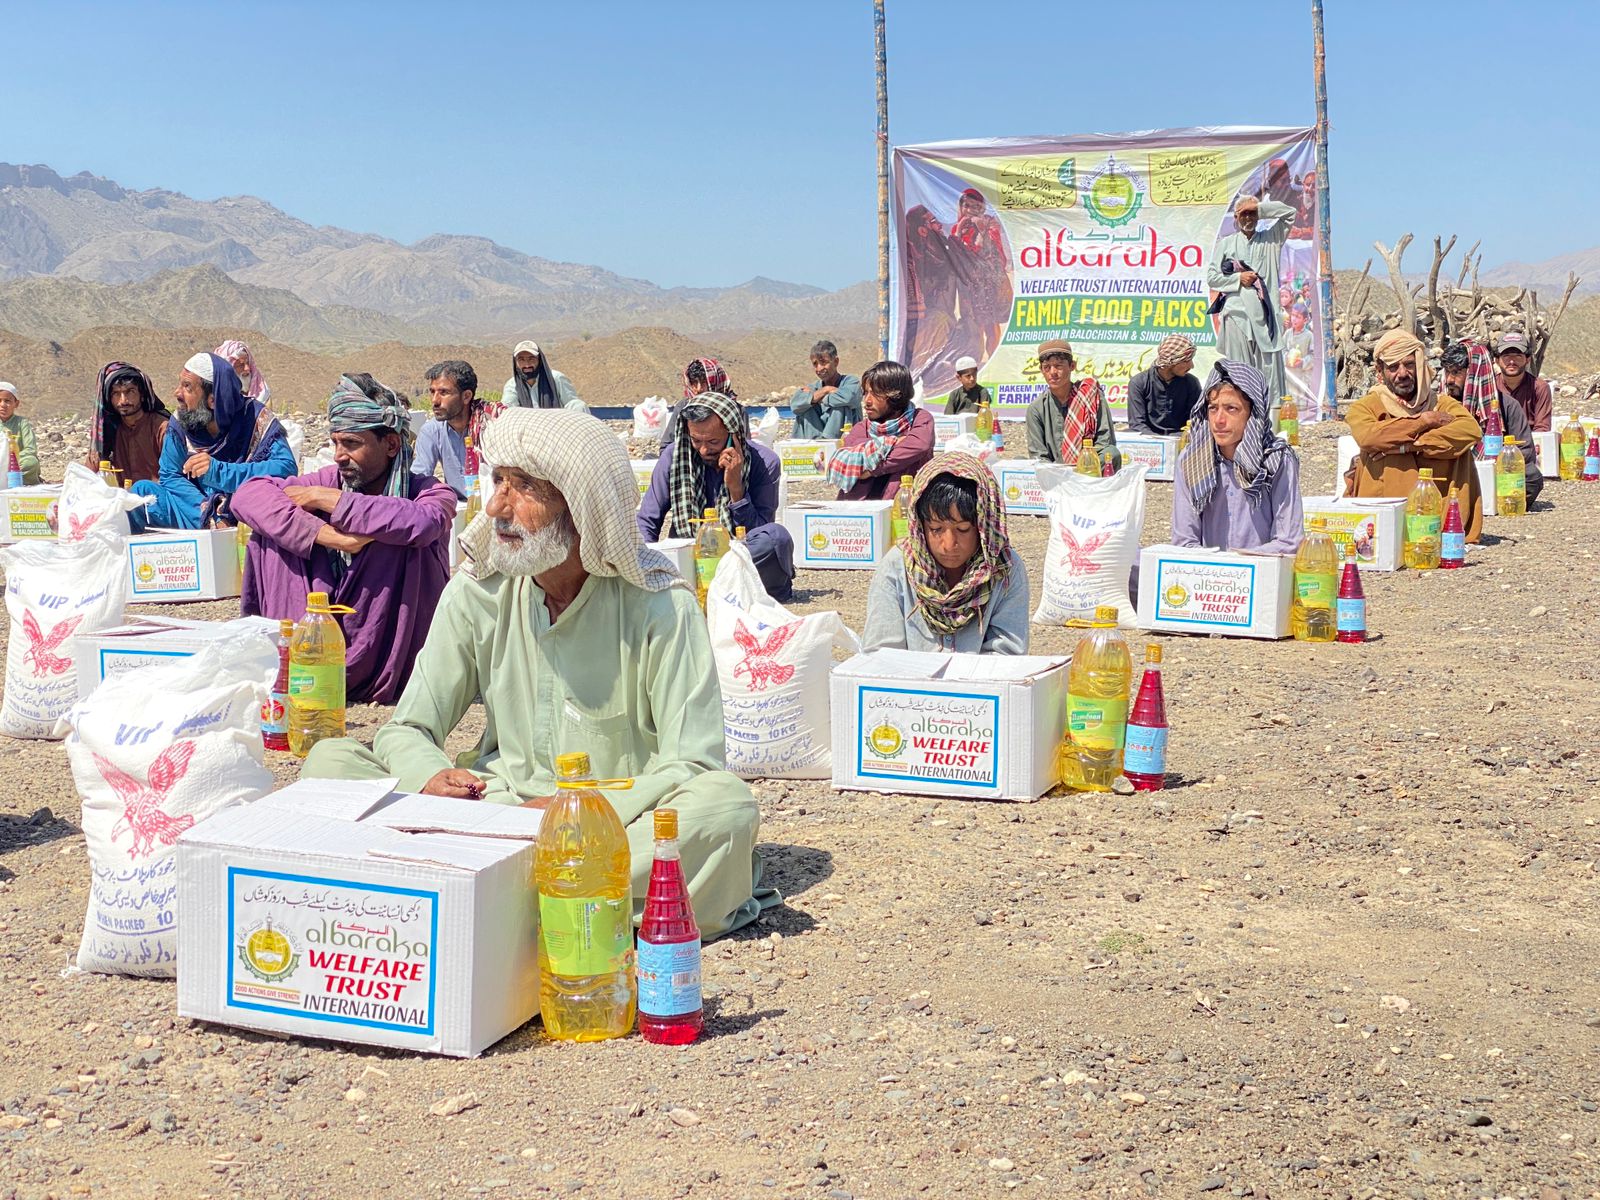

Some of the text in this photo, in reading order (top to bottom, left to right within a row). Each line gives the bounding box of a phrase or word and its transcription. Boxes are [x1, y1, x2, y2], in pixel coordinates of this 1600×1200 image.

[1020, 227, 1203, 275] albaraka
[1021, 279, 1203, 294] WELFARE TRUST INTERNATIONAL
[1016, 299, 1207, 328] FAMILY FOOD PACKS
[1006, 330, 1060, 342] DISTRIBUTION
[1061, 329, 1070, 339] IN
[1069, 328, 1129, 341] BALOCHISTAN
[1130, 329, 1138, 341] &
[999, 384, 1032, 393] HAKEEM
[1072, 514, 1096, 529] VIP
[832, 538, 870, 546] WELFARE
[158, 566, 195, 574] WELFARE
[38, 593, 69, 609] VIP
[1194, 592, 1248, 604] WELFARE
[1201, 603, 1239, 614] TRUST
[1191, 612, 1248, 624] INTERNATIONAL
[768, 728, 779, 739] 10
[781, 723, 797, 736] KG
[911, 715, 993, 740] albaraka
[913, 735, 991, 754] WELFARE
[923, 751, 979, 767] TRUST
[771, 767, 786, 775] FAX
[909, 764, 992, 782] INTERNATIONAL
[285, 888, 310, 909] شب
[326, 897, 356, 915] خدمت
[354, 895, 371, 917] کی
[114, 917, 145, 930] PACKED
[157, 910, 173, 926] 10
[366, 904, 402, 921] انسانیت
[306, 917, 429, 959] albaraka
[308, 948, 426, 982] WELFARE
[235, 985, 247, 993] GOOD
[248, 987, 266, 995] ACTIONS
[277, 991, 300, 1000] STRENGTH
[324, 973, 407, 1002] TRUST
[303, 993, 427, 1026] INTERNATIONAL
